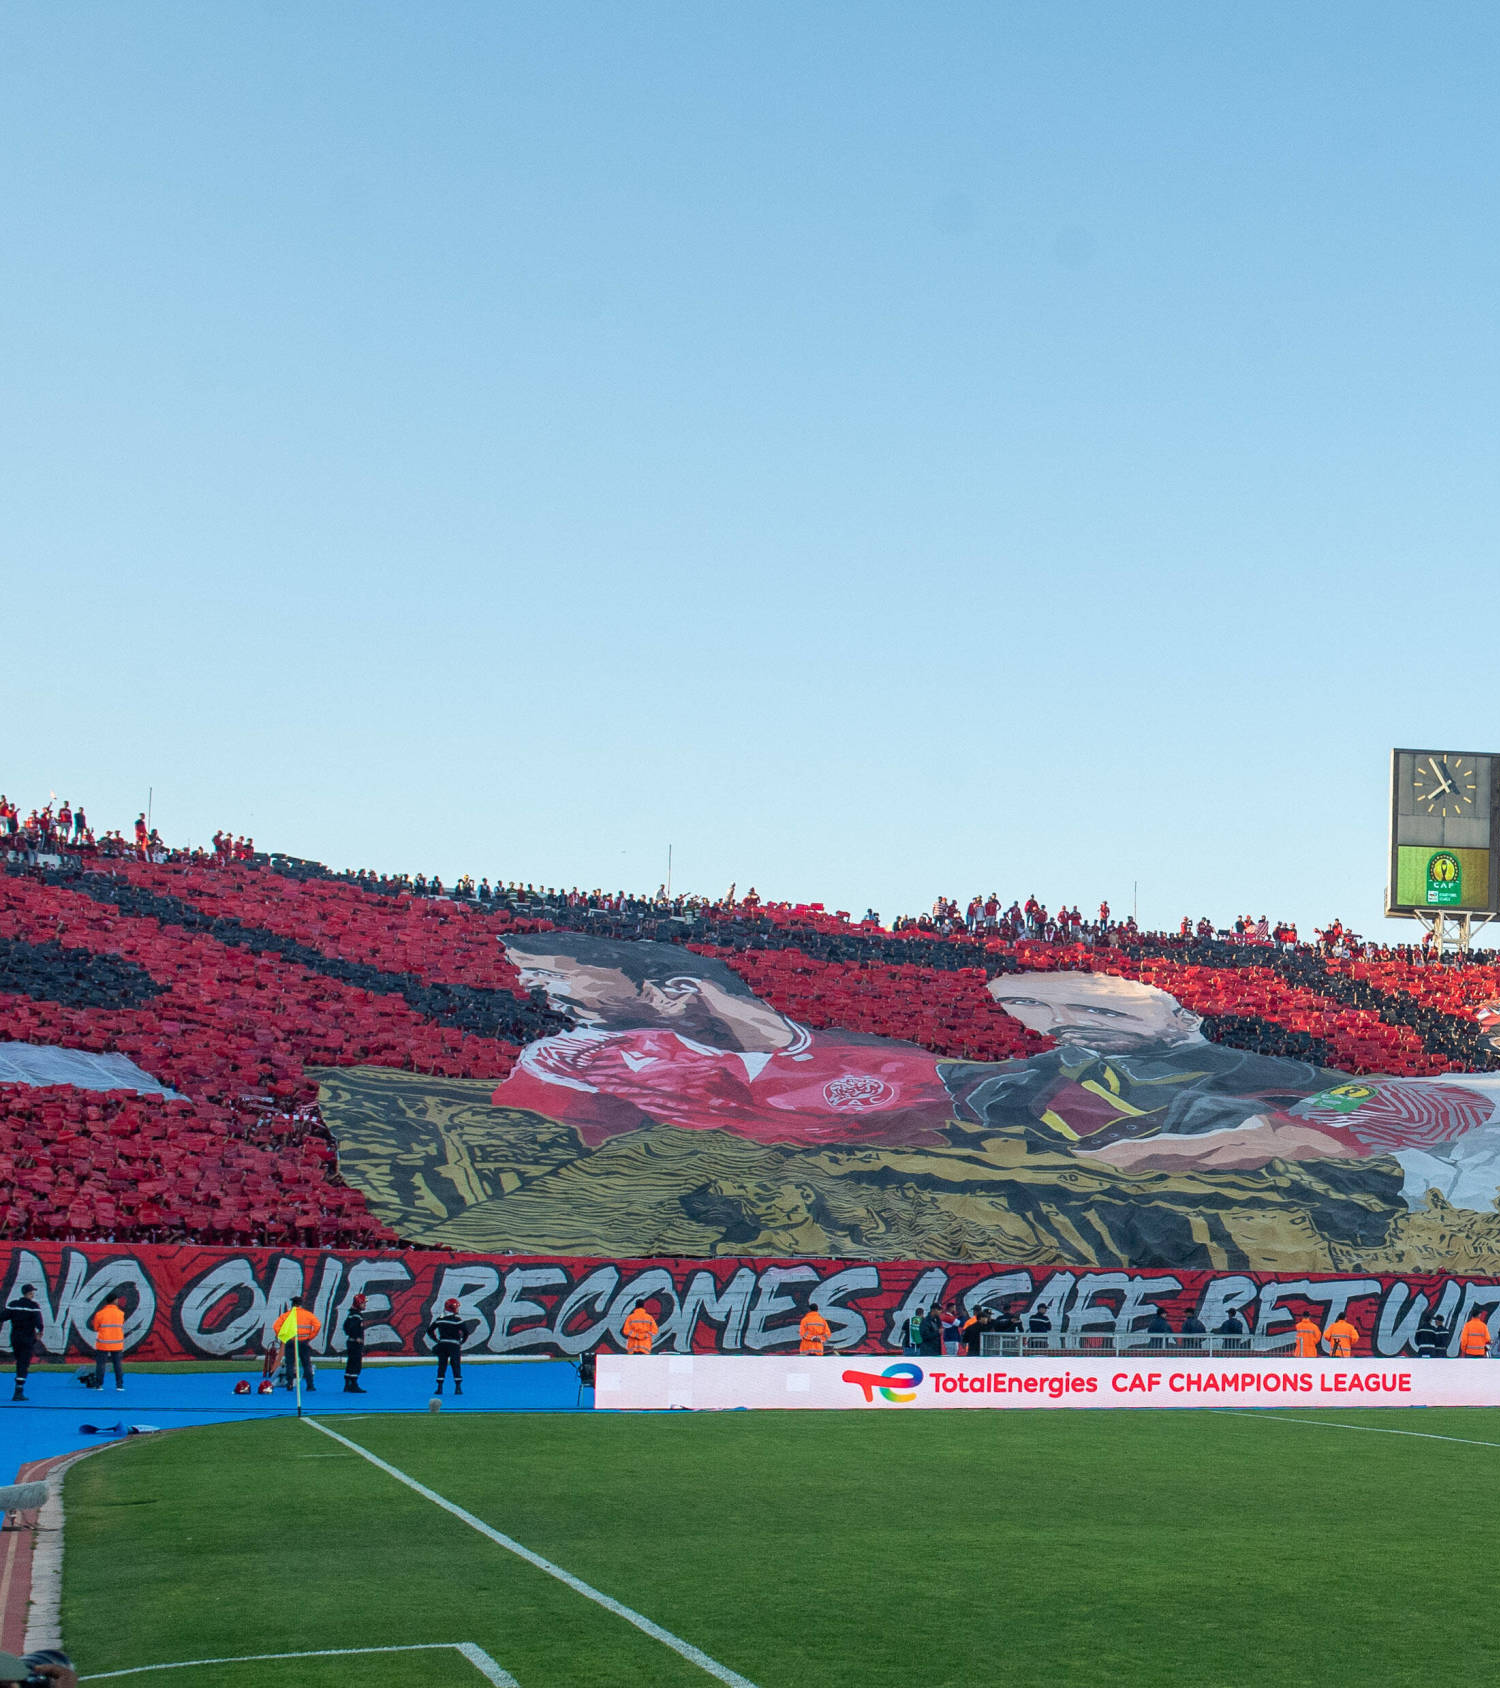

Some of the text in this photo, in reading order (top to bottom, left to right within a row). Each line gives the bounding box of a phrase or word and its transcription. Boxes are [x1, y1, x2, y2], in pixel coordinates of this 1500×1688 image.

[0, 1249, 156, 1355] NO
[181, 1256, 412, 1356] ONE
[425, 1266, 879, 1354] BECOMES
[1197, 1275, 1382, 1354] BET
[929, 1372, 1411, 1398] TotalEnergies CAF CHAMPIONS LEAGUE
